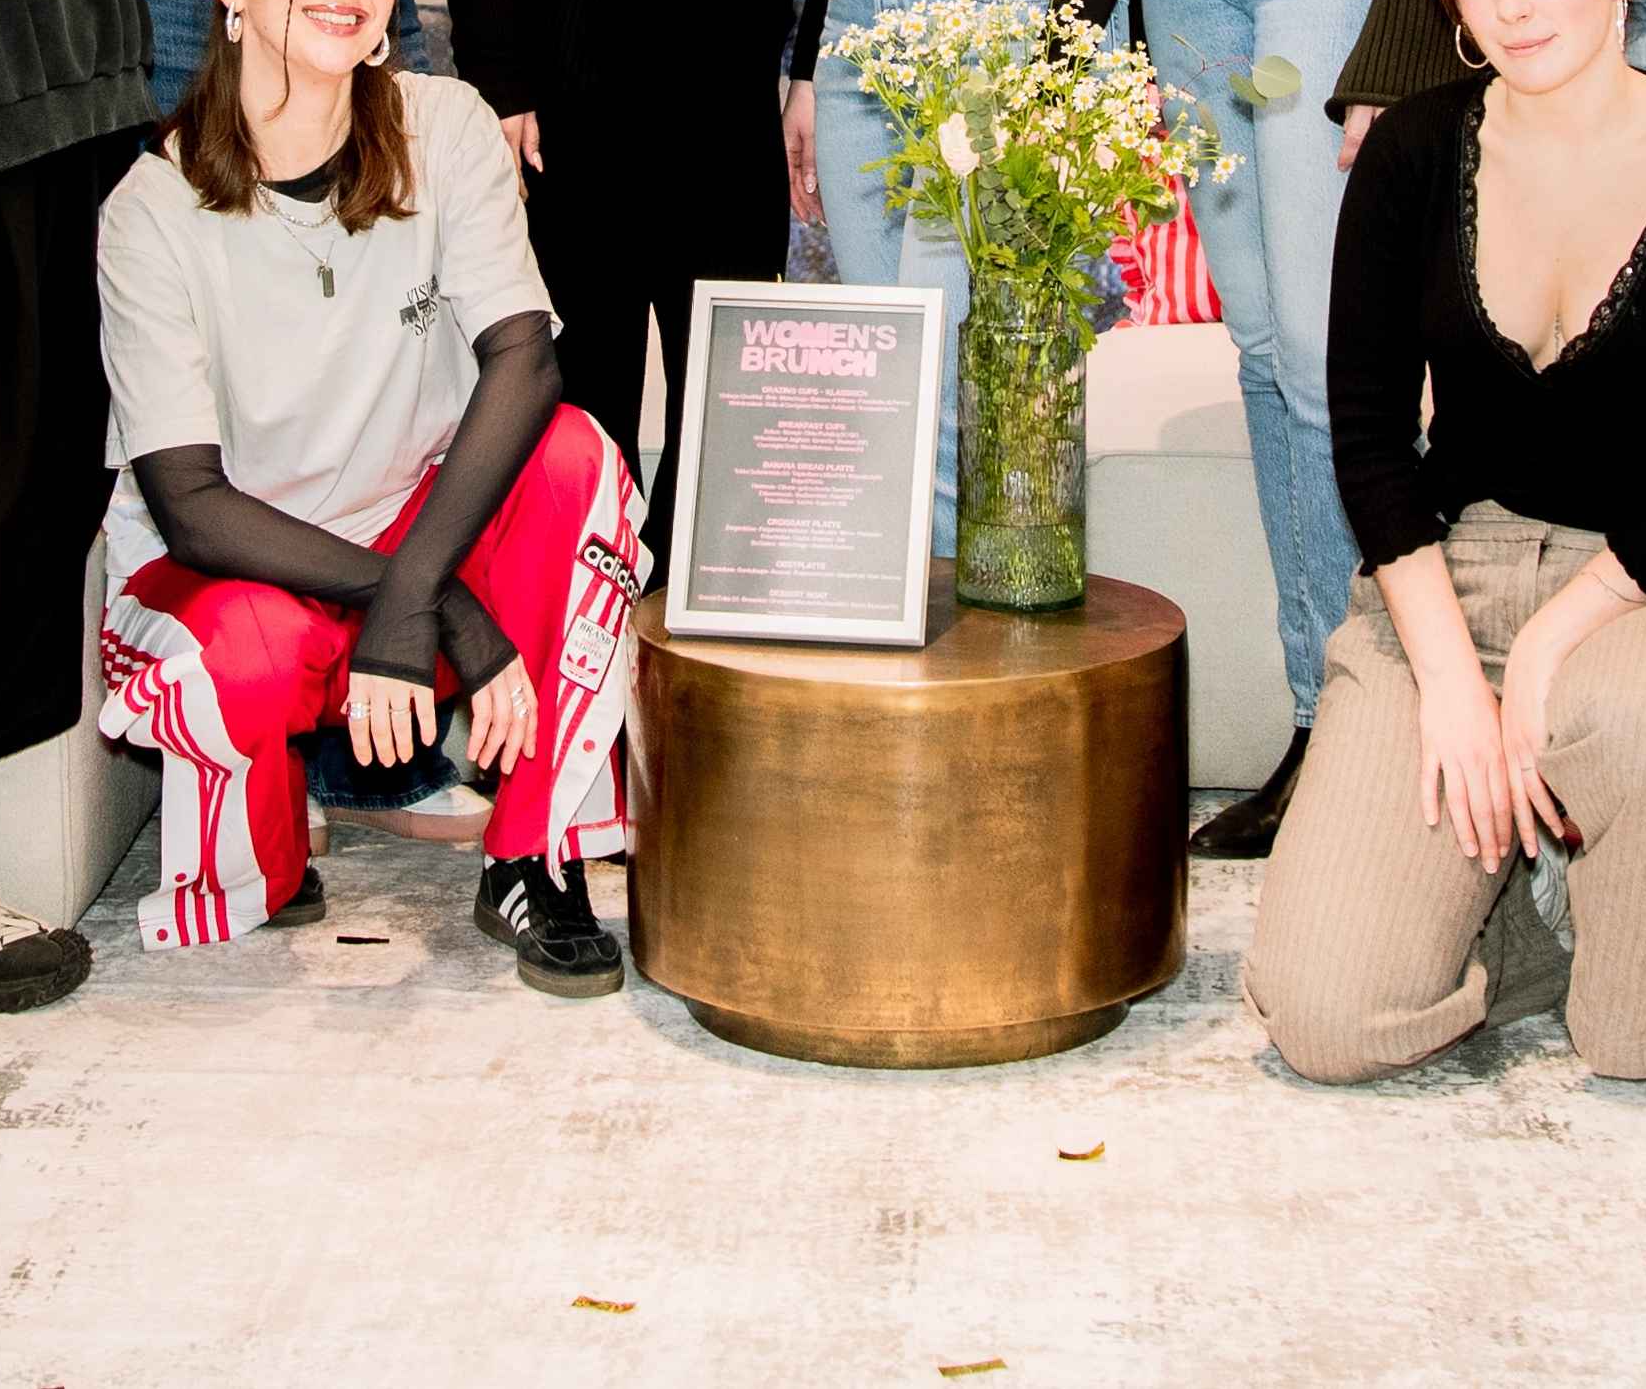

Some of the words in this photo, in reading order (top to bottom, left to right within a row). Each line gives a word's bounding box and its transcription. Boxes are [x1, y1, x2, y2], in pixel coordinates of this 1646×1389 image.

[742, 319, 898, 351] WOMEN'S
[740, 346, 878, 378] BRUNCH
[583, 545, 640, 605] adidas
